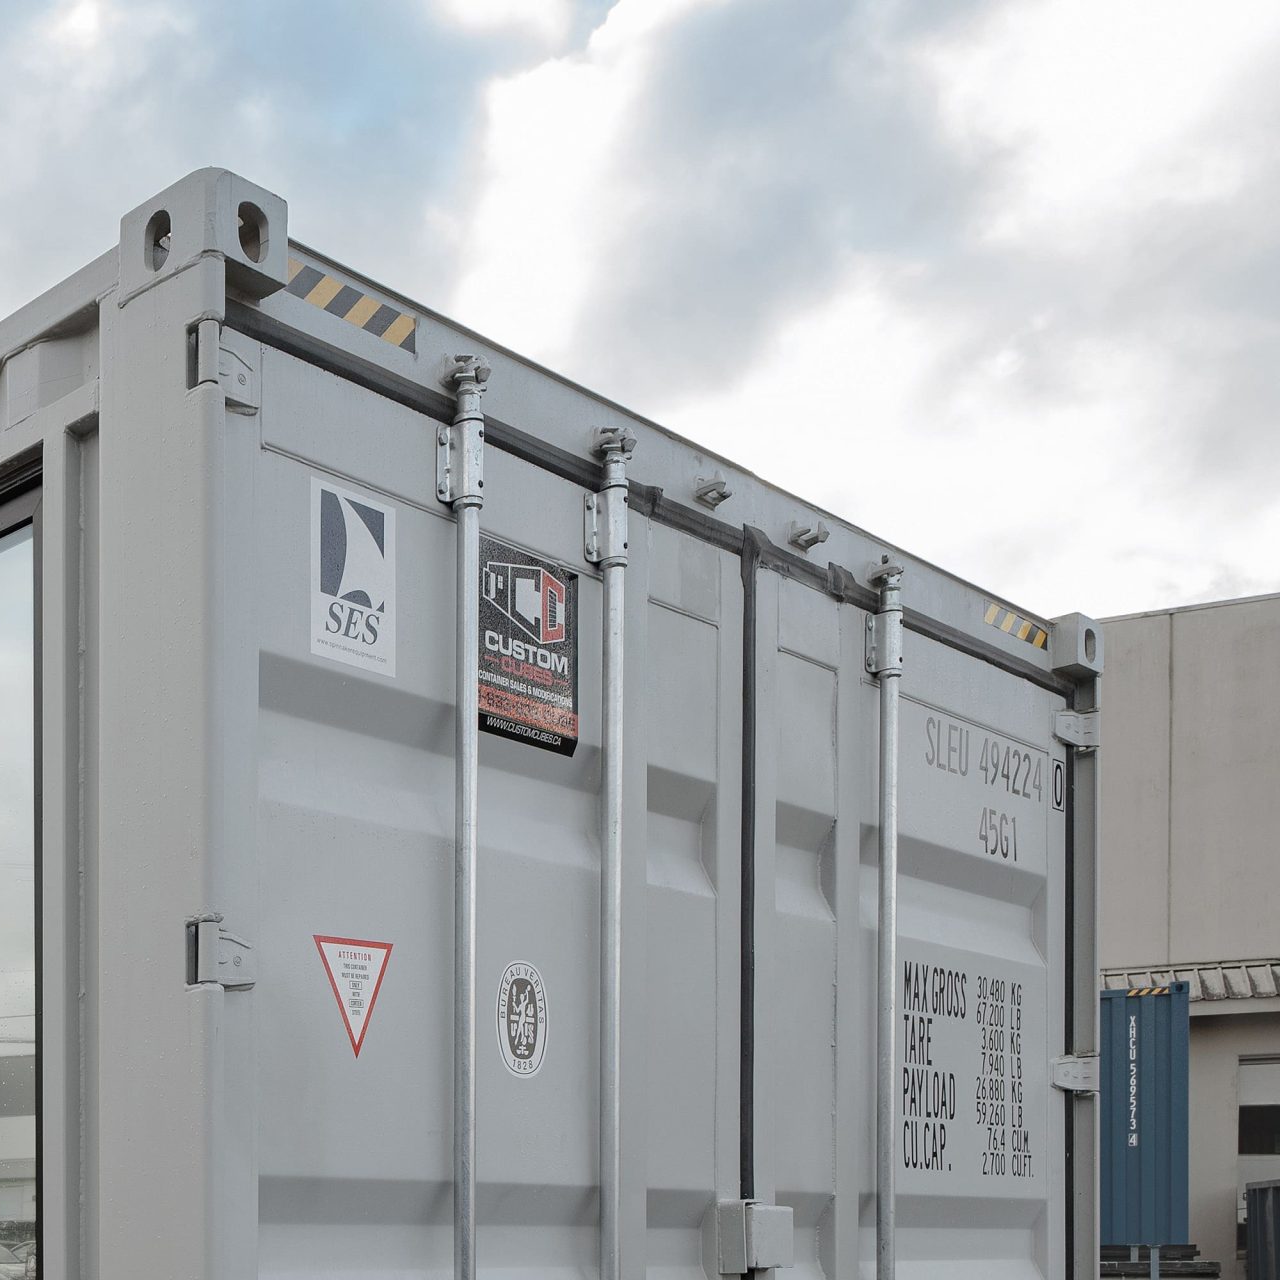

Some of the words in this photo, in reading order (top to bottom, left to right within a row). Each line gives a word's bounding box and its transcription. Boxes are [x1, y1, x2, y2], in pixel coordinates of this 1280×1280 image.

[325, 602, 380, 646] SES
[484, 630, 568, 675] CUSTOM
[478, 670, 510, 688] CONTAINER
[509, 679, 527, 694] SALES
[486, 716, 562, 746] WWW.CUSTOMCUBES.CA
[925, 717, 969, 777] SLEU
[979, 738, 1043, 802] 494224
[978, 807, 1018, 862] 45G1
[338, 951, 372, 961] ATTENTION
[500, 967, 521, 1019] BUREAU
[524, 967, 544, 1024] VERITAS
[903, 961, 930, 1013] MAX
[932, 967, 967, 1019] GROSS
[1011, 983, 1022, 1006] KG
[903, 1014, 933, 1066] TARE
[1010, 1031, 1021, 1055] KG
[1010, 1007, 1021, 1031] LB
[1129, 1015, 1137, 1060] XHCU
[512, 1060, 533, 1070] 1828
[1010, 1057, 1022, 1080] LB
[903, 1067, 956, 1120] PAYLOAD
[1011, 1081, 1023, 1104] KG
[1129, 1063, 1137, 1130] 569573
[1011, 1105, 1023, 1129] LB
[987, 1128, 1006, 1151] 76.4
[1129, 1134, 1137, 1146] 4
